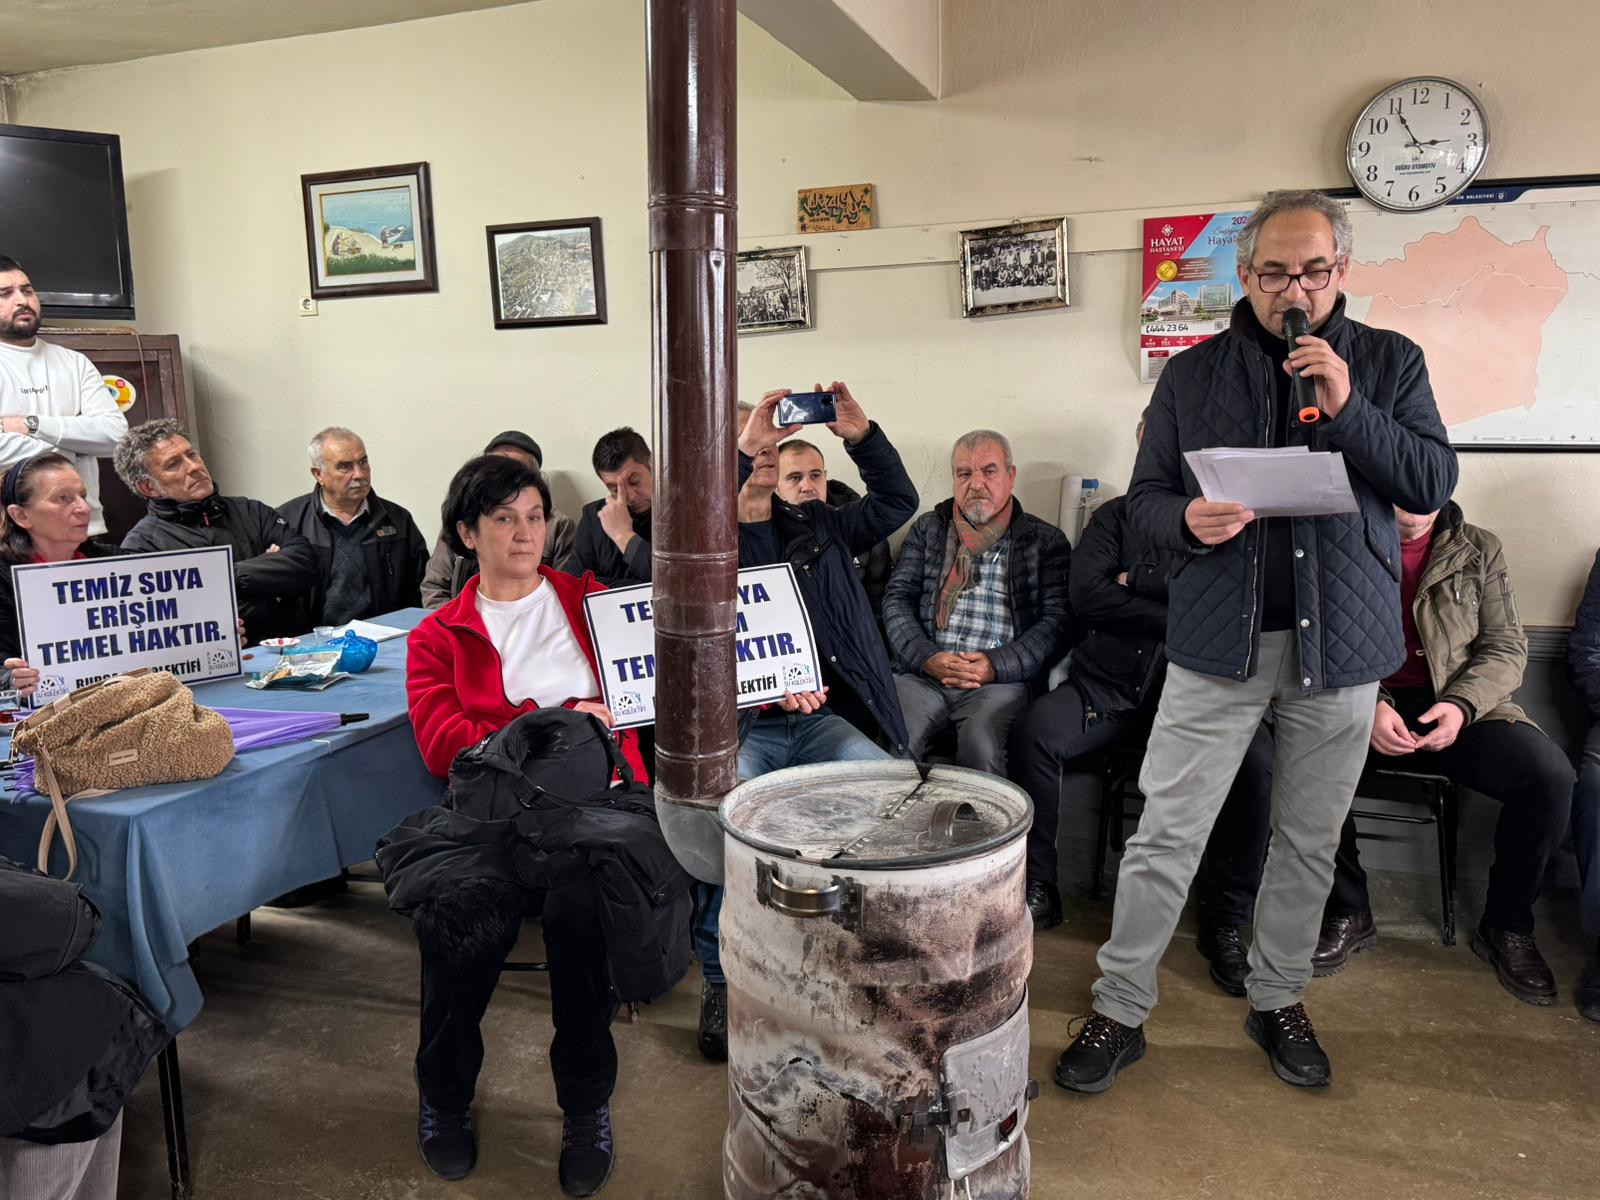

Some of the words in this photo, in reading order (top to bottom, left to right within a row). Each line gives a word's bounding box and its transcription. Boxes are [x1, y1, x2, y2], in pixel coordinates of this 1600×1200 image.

[1411, 87, 1430, 105] 12
[1444, 92, 1451, 109] 1
[1388, 98, 1403, 115] 11
[1368, 117, 1388, 135] 10
[1460, 109, 1471, 126] 2
[1466, 133, 1478, 149] 3
[1358, 141, 1371, 159] 9
[1366, 165, 1378, 182] 8
[1456, 157, 1467, 174] 4
[1384, 180, 1395, 197] 7
[1408, 185, 1420, 202] 6
[1434, 176, 1447, 194] 5
[1150, 237, 1184, 247] HAYAT
[1150, 325, 1165, 333] 444
[1167, 324, 1177, 332] 23
[52, 572, 133, 604] TEMİZ
[138, 567, 203, 595] SUYA
[87, 597, 178, 630] ERİŞİM
[37, 634, 123, 666] TEMEL
[128, 621, 226, 652] HAKTIR.
